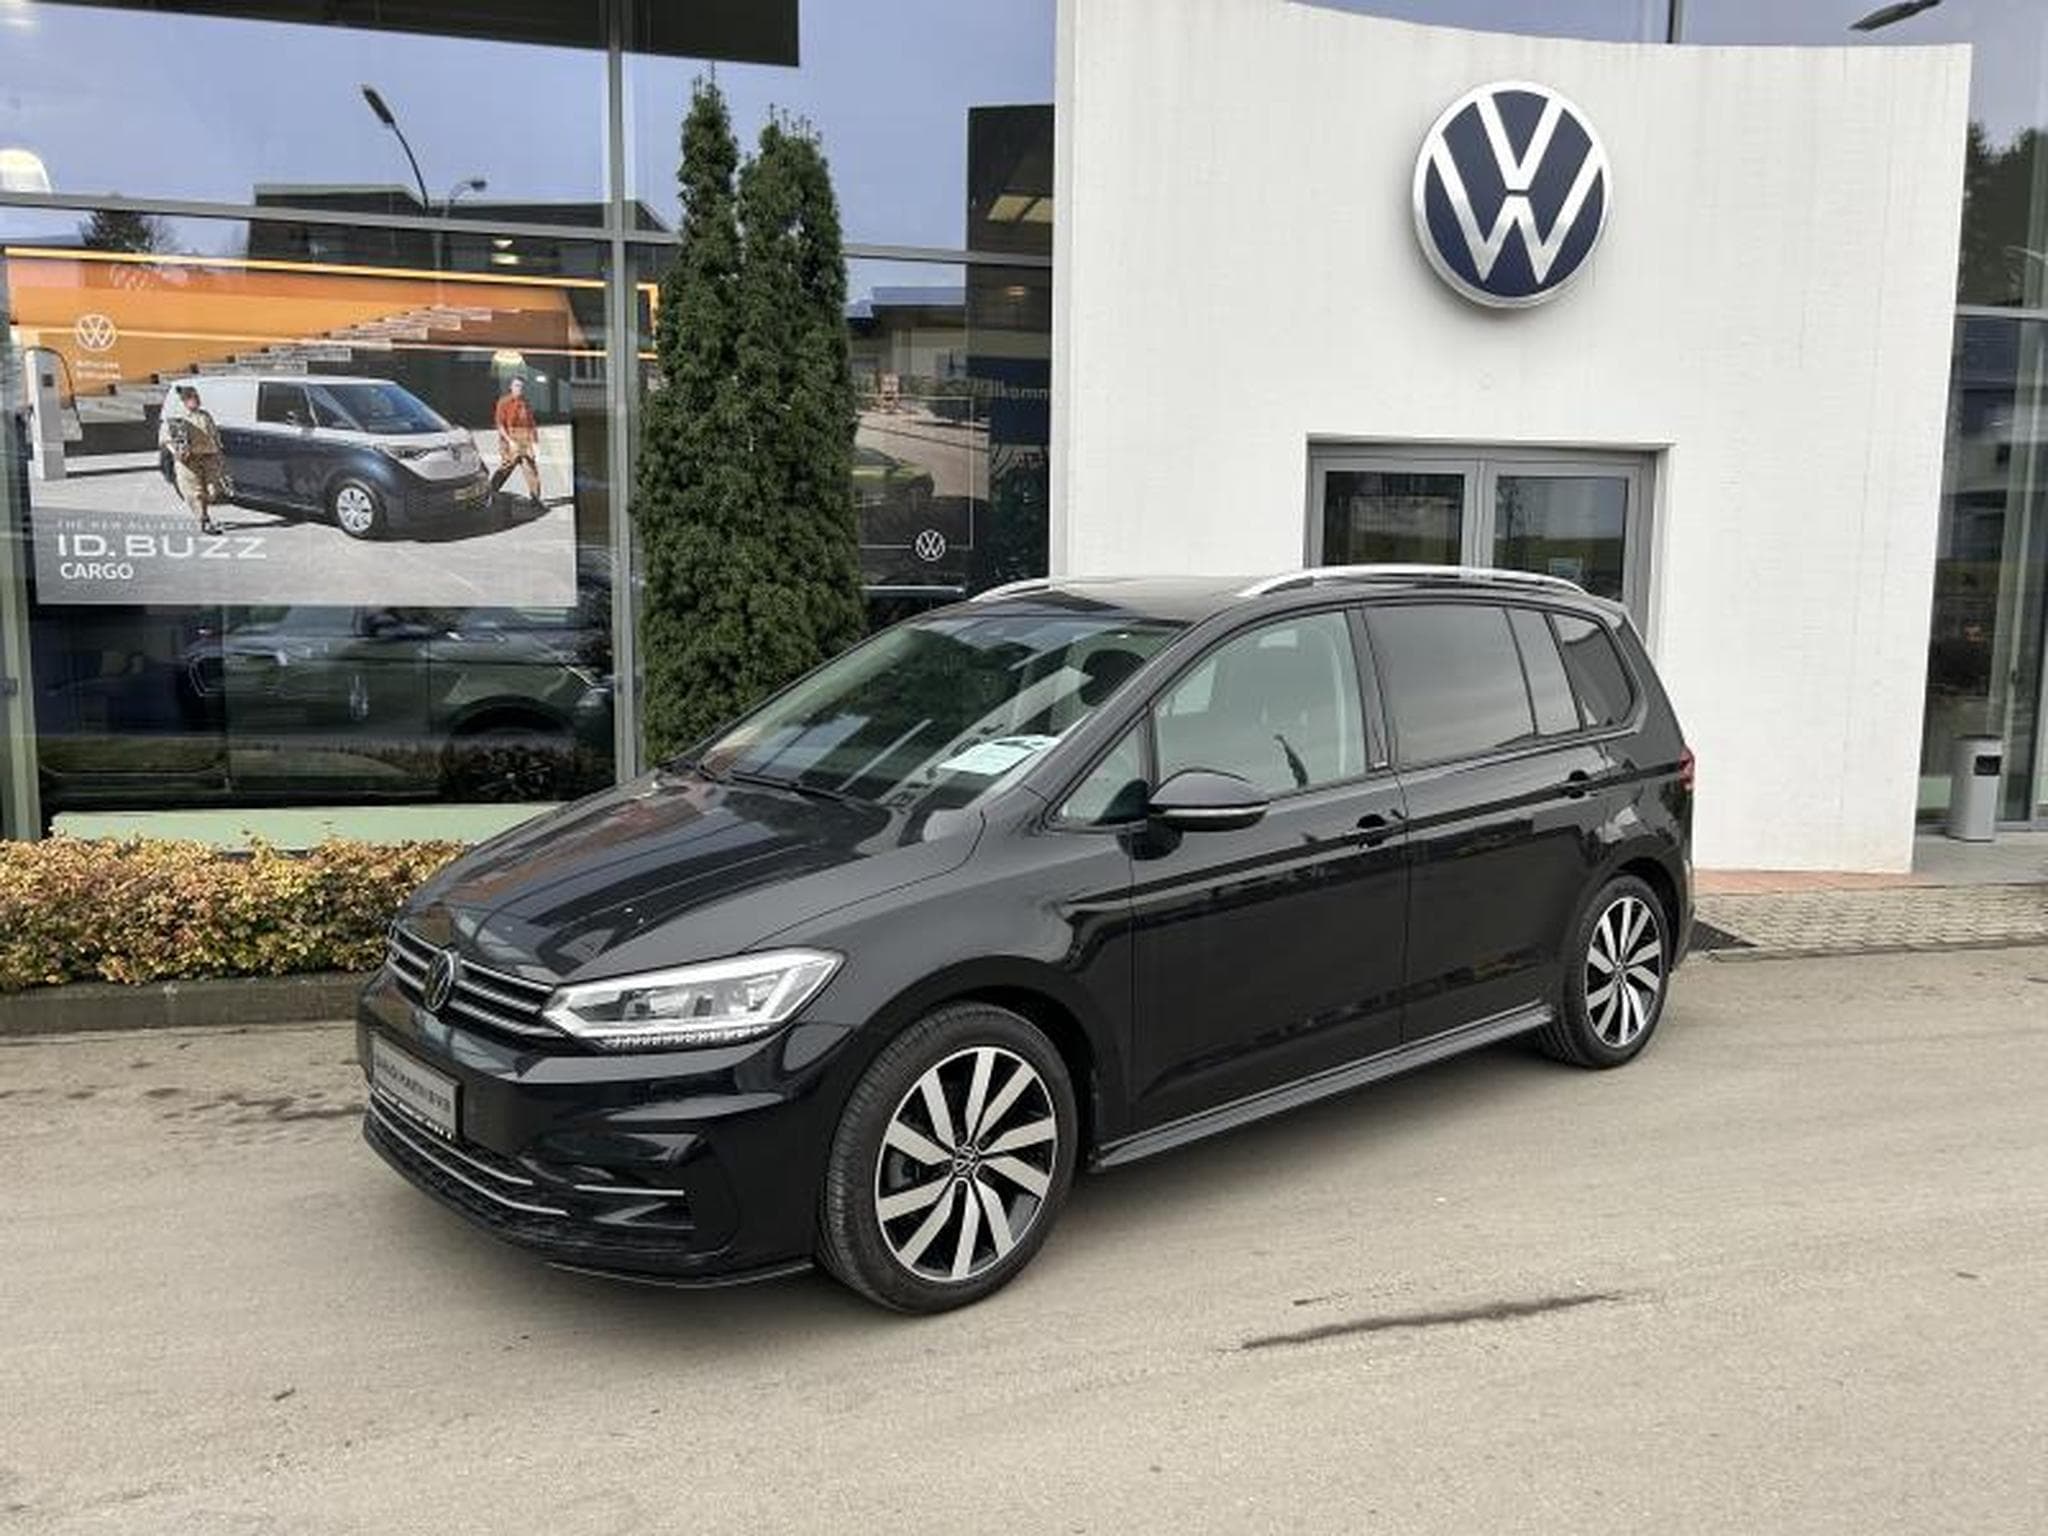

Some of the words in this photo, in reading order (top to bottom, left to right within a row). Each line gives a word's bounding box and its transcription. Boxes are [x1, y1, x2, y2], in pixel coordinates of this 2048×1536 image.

[1418, 83, 1609, 302] VW
[57, 533, 116, 557] ID.
[125, 534, 267, 560] BUZZ
[60, 562, 134, 580] CARGO
